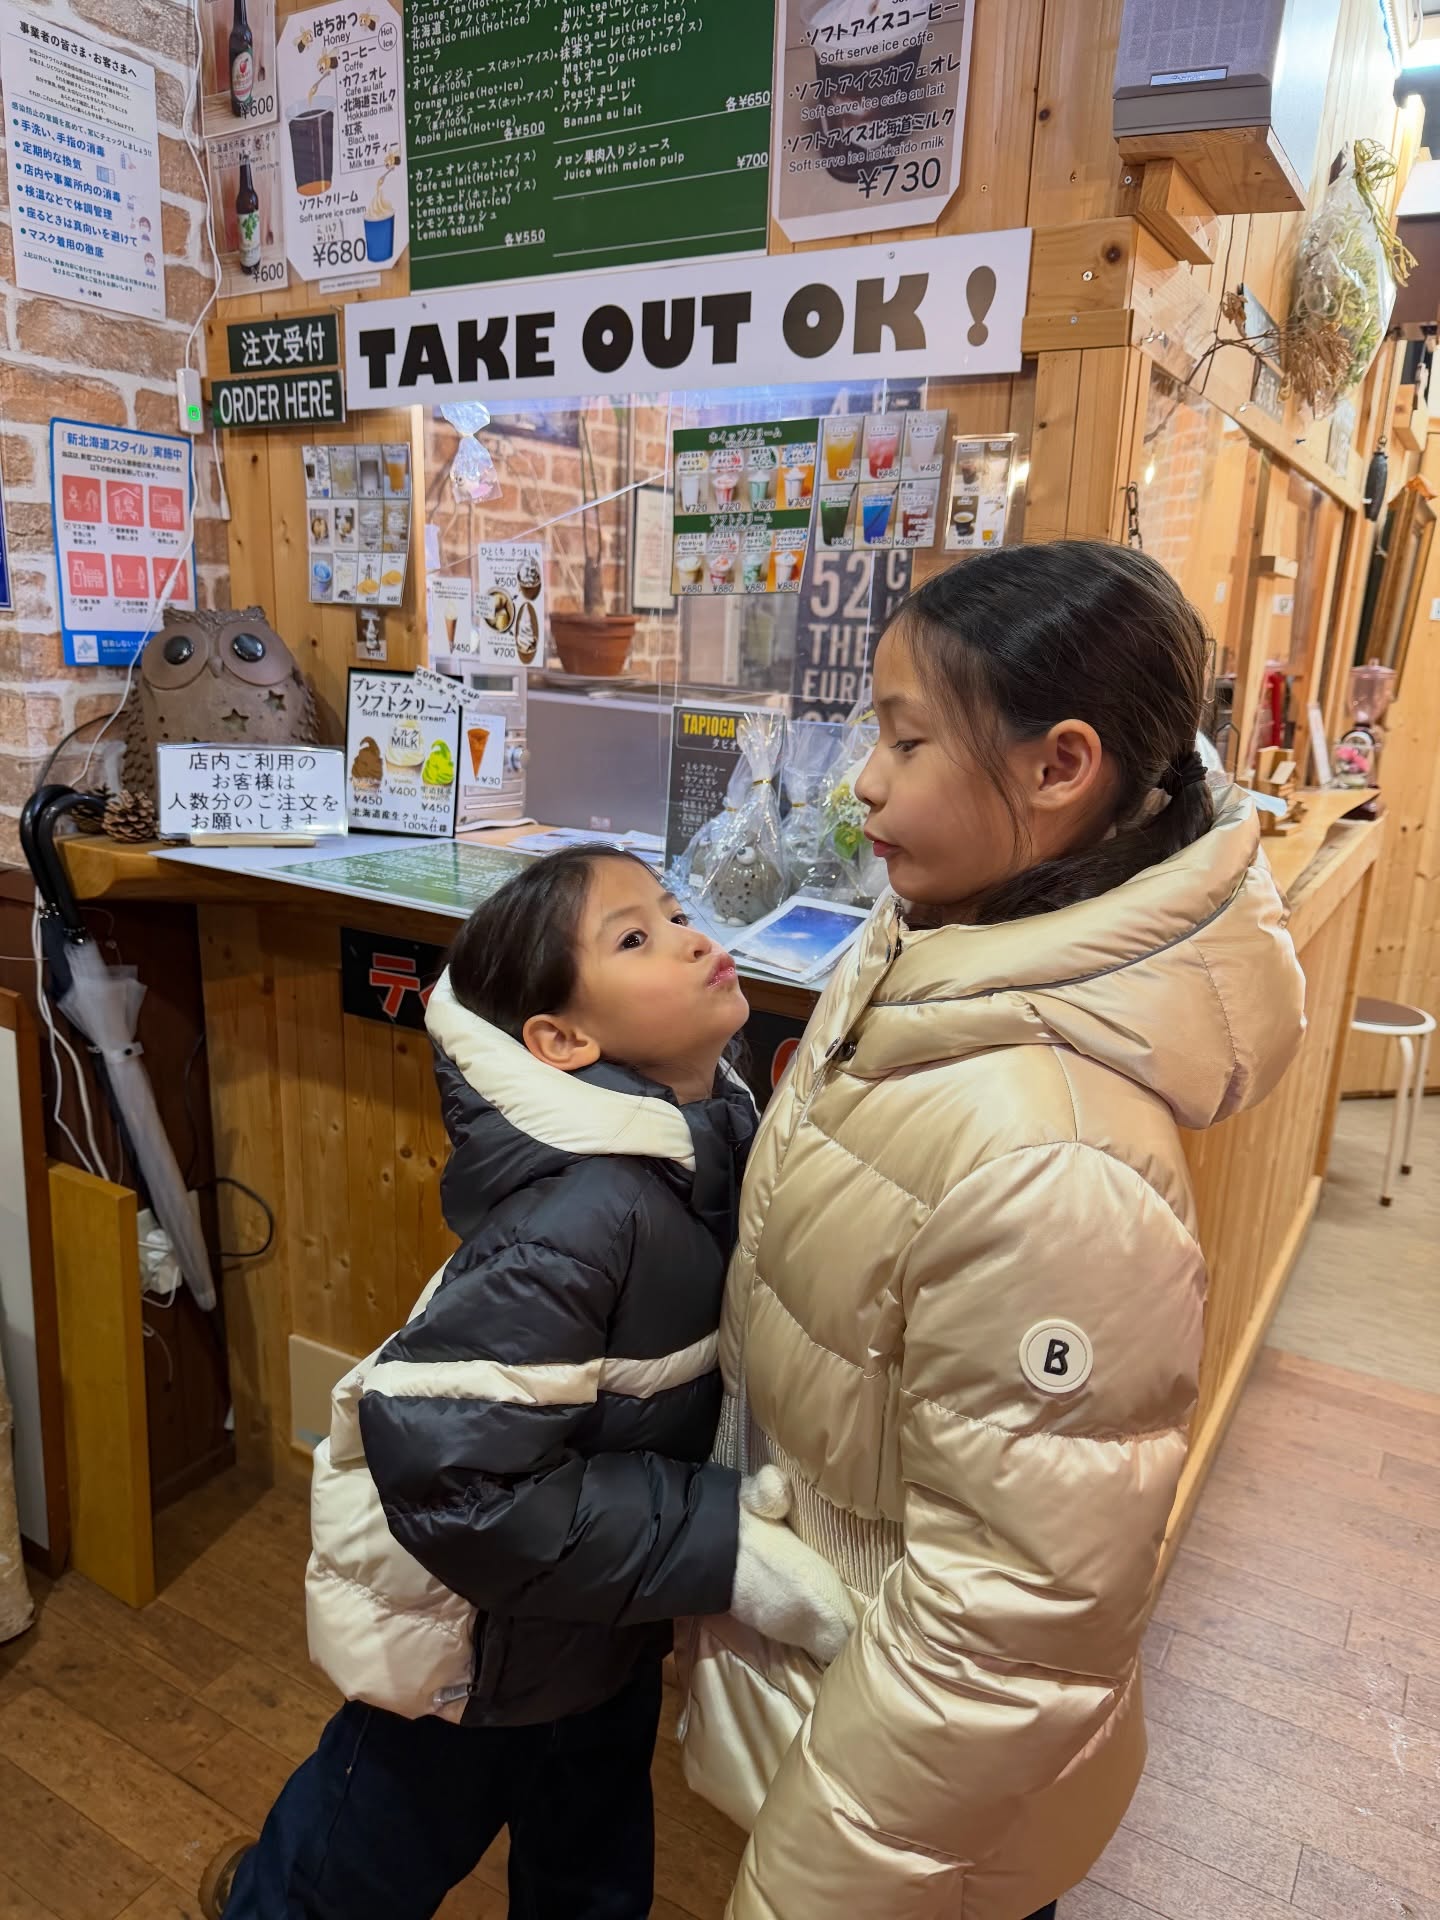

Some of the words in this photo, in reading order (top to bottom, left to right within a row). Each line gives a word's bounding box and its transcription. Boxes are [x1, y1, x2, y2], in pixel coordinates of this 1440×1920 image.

[412, 10, 445, 25] Oolong
[564, 5, 585, 19] Milk
[313, 12, 359, 38] はちみつ
[380, 27, 393, 37] Hot
[806, 3, 959, 45] ソフトアイスコーヒー
[323, 32, 351, 47] Honey
[383, 40, 393, 48] Ice
[412, 33, 457, 51] Hokkaido
[564, 33, 589, 46] Anko
[594, 29, 607, 40] au
[820, 47, 844, 64] Soft
[847, 45, 879, 58] serve
[882, 39, 900, 52] ice
[902, 30, 935, 48] coffe
[19, 21, 137, 77] 事業者の皆さま・お客さまへ
[341, 46, 377, 62] コーヒー
[413, 48, 441, 64] コーラ
[343, 66, 387, 87] カフェオレ
[413, 64, 434, 76] Cola
[561, 65, 619, 88] ももオーレ
[563, 60, 603, 74] Matcha
[795, 53, 960, 100] ソフトアイスカフェオレ
[346, 85, 362, 97] Cafe
[363, 85, 372, 94] au
[372, 81, 383, 91] lait
[563, 85, 596, 101] Peach
[600, 84, 613, 94] au
[617, 77, 636, 90] lait
[344, 88, 396, 112] 北海道ミルク
[414, 97, 448, 111] Orange
[560, 91, 631, 113] バナナオーレ
[725, 90, 771, 112] 各¥650
[801, 104, 825, 121] Soft
[827, 102, 859, 116] serve
[861, 96, 878, 109] ice
[880, 91, 906, 106] cafe
[909, 87, 924, 100] au
[926, 82, 945, 96] lait
[346, 108, 378, 121] Hokkaido
[379, 104, 393, 116] milk
[563, 113, 602, 128] Banana
[606, 110, 619, 120] au
[623, 104, 642, 117] lait
[21, 119, 105, 158] 手洗い、手指の消毒
[345, 122, 363, 137] 紅茶
[415, 132, 441, 145] Apple
[504, 121, 546, 140] 各¥500
[787, 107, 956, 153] ソフトアイス北海道ミルク
[348, 134, 366, 146] Black
[368, 133, 379, 142] tea
[22, 141, 83, 172] 定期的な換気
[346, 142, 399, 159] ミルクティー
[554, 138, 670, 168] メロン果肉入りジュース
[789, 157, 812, 172] Soft
[814, 155, 846, 169] serve
[848, 150, 864, 164] ice
[867, 141, 918, 162] hokkaido
[920, 135, 945, 151] milk
[349, 159, 363, 169] Milk
[364, 159, 375, 167] tea
[564, 168, 592, 181] Juice
[595, 161, 619, 176] with
[622, 157, 656, 171] melon
[660, 152, 685, 168] pulp
[736, 152, 769, 169] ¥700
[23, 163, 121, 203] 店内や事業所内の消毒
[416, 179, 438, 193] Cafe
[441, 179, 452, 189] au
[858, 157, 941, 198] ¥730
[25, 184, 113, 221] 検温などで体調管理
[299, 190, 359, 210] ソフトクリーム
[300, 213, 313, 223] Soft
[315, 211, 333, 220] serve
[334, 208, 344, 217] ice
[345, 206, 367, 216] cream
[416, 210, 497, 231] レモンスカッシュ
[26, 207, 138, 247] 座るときは真向いを避けて
[417, 228, 448, 241] Lemon
[451, 223, 484, 237] squash
[28, 228, 105, 258] マスク着用の徹底
[504, 229, 546, 247] 各¥550
[312, 238, 366, 268] ¥680
[252, 262, 284, 283] ¥600
[359, 310, 556, 389] TAKE
[582, 290, 752, 374] OUT
[782, 274, 929, 360] OK
[241, 322, 325, 367] 注文受付
[220, 383, 280, 424] ORDER
[284, 379, 335, 419] HERE
[495, 577, 517, 587] ¥500
[810, 552, 872, 619] 52
[494, 647, 516, 658] ¥700
[808, 624, 875, 667] THE
[353, 678, 414, 695] プレミアム
[416, 668, 443, 684] cone
[447, 682, 457, 690] or
[461, 689, 480, 700] cup
[357, 694, 457, 715] ソフトクリーム
[362, 709, 379, 717] Soft
[381, 712, 405, 720] serve
[406, 713, 418, 721] ice
[420, 715, 447, 723] cream
[393, 728, 419, 737] ミルク
[683, 714, 736, 738] TAPIOCA
[391, 736, 418, 749] MILK
[712, 738, 737, 750] タピオ
[189, 752, 316, 771] 店内ご利用の
[212, 772, 295, 791] お客様は
[353, 795, 383, 806] ¥450
[389, 786, 417, 797] ¥400
[167, 792, 339, 811] 人数分のご注文を
[421, 802, 450, 814] ¥450
[191, 813, 318, 831] お願いします
[351, 808, 438, 823] 北海道産生クリーム
[1043, 1338, 1070, 1376] B
